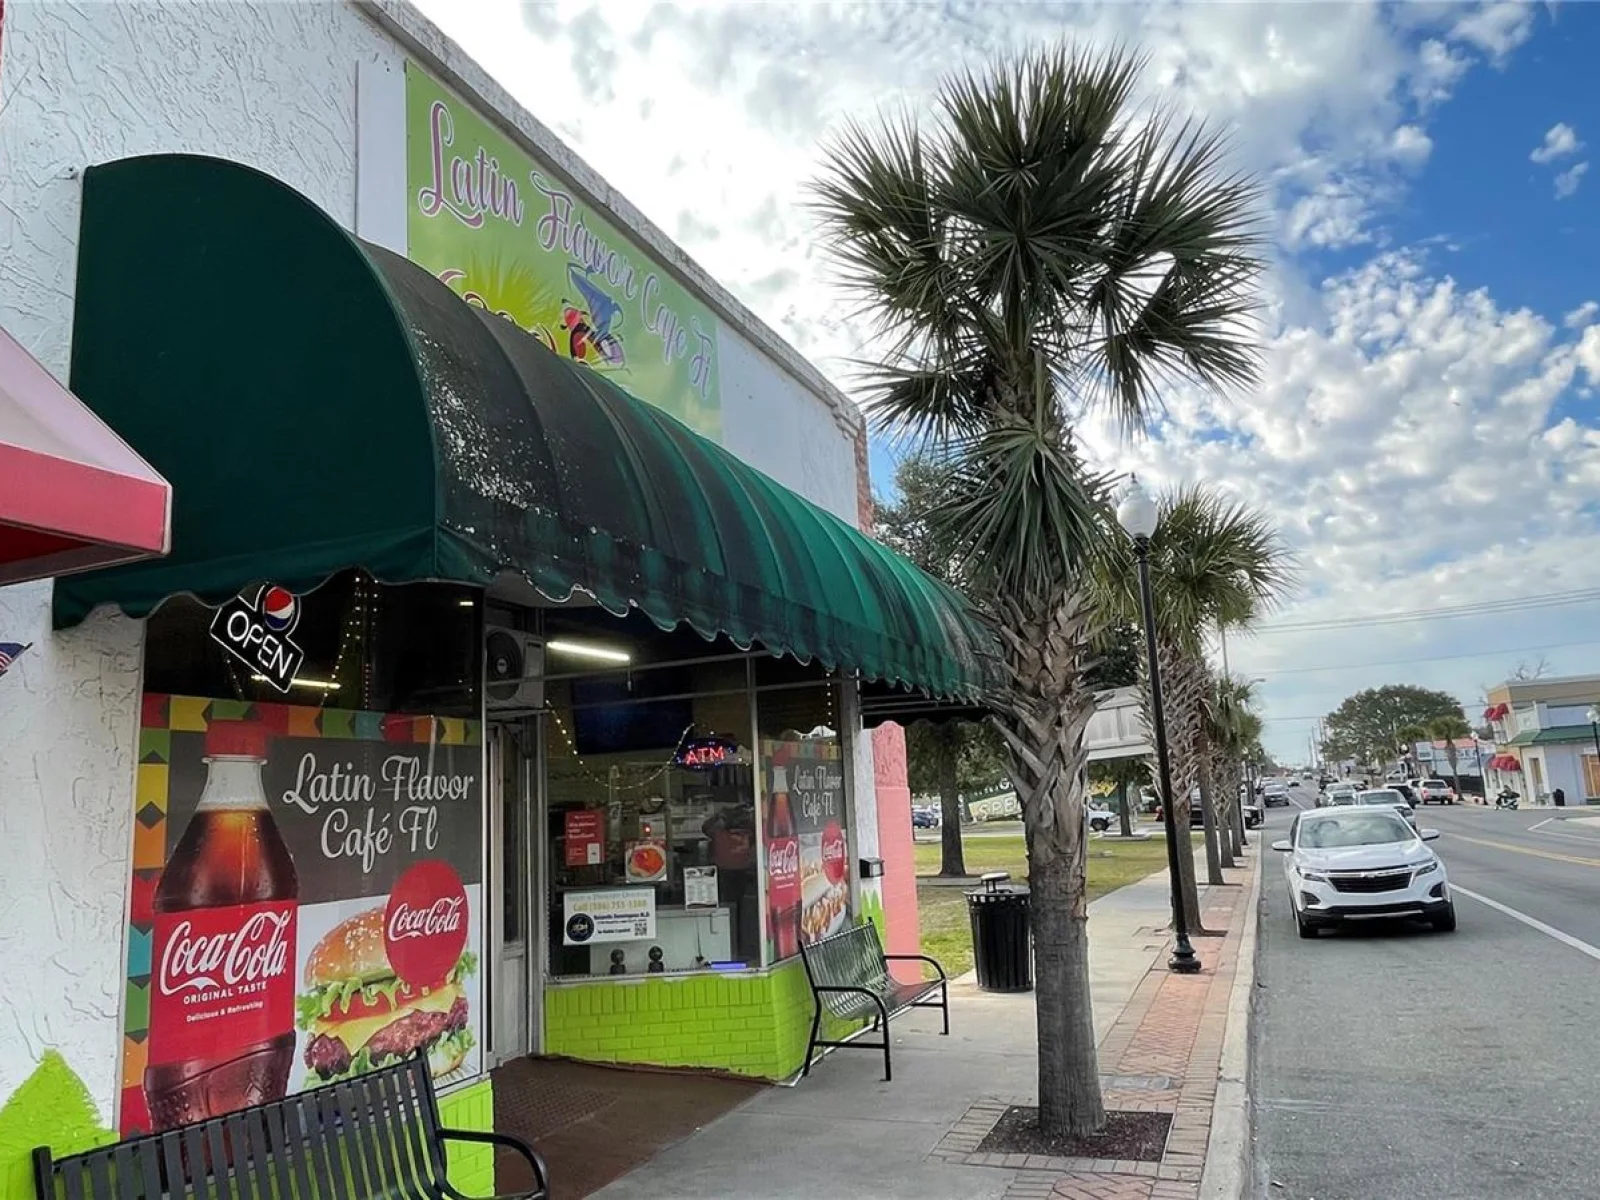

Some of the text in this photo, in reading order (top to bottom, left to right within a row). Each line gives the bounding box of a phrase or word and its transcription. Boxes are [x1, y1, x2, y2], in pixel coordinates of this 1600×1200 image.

[419, 100, 524, 229] Latin
[530, 171, 638, 300] Flavor
[227, 610, 294, 679] OPEN
[283, 752, 475, 814] Latin Flavor
[686, 745, 725, 765] ATM
[320, 805, 439, 873] Café Fl
[388, 895, 465, 942] Coca-Cola
[159, 909, 292, 996] Coca-Cola
[183, 981, 267, 1005] ORIGINAL TASTE
